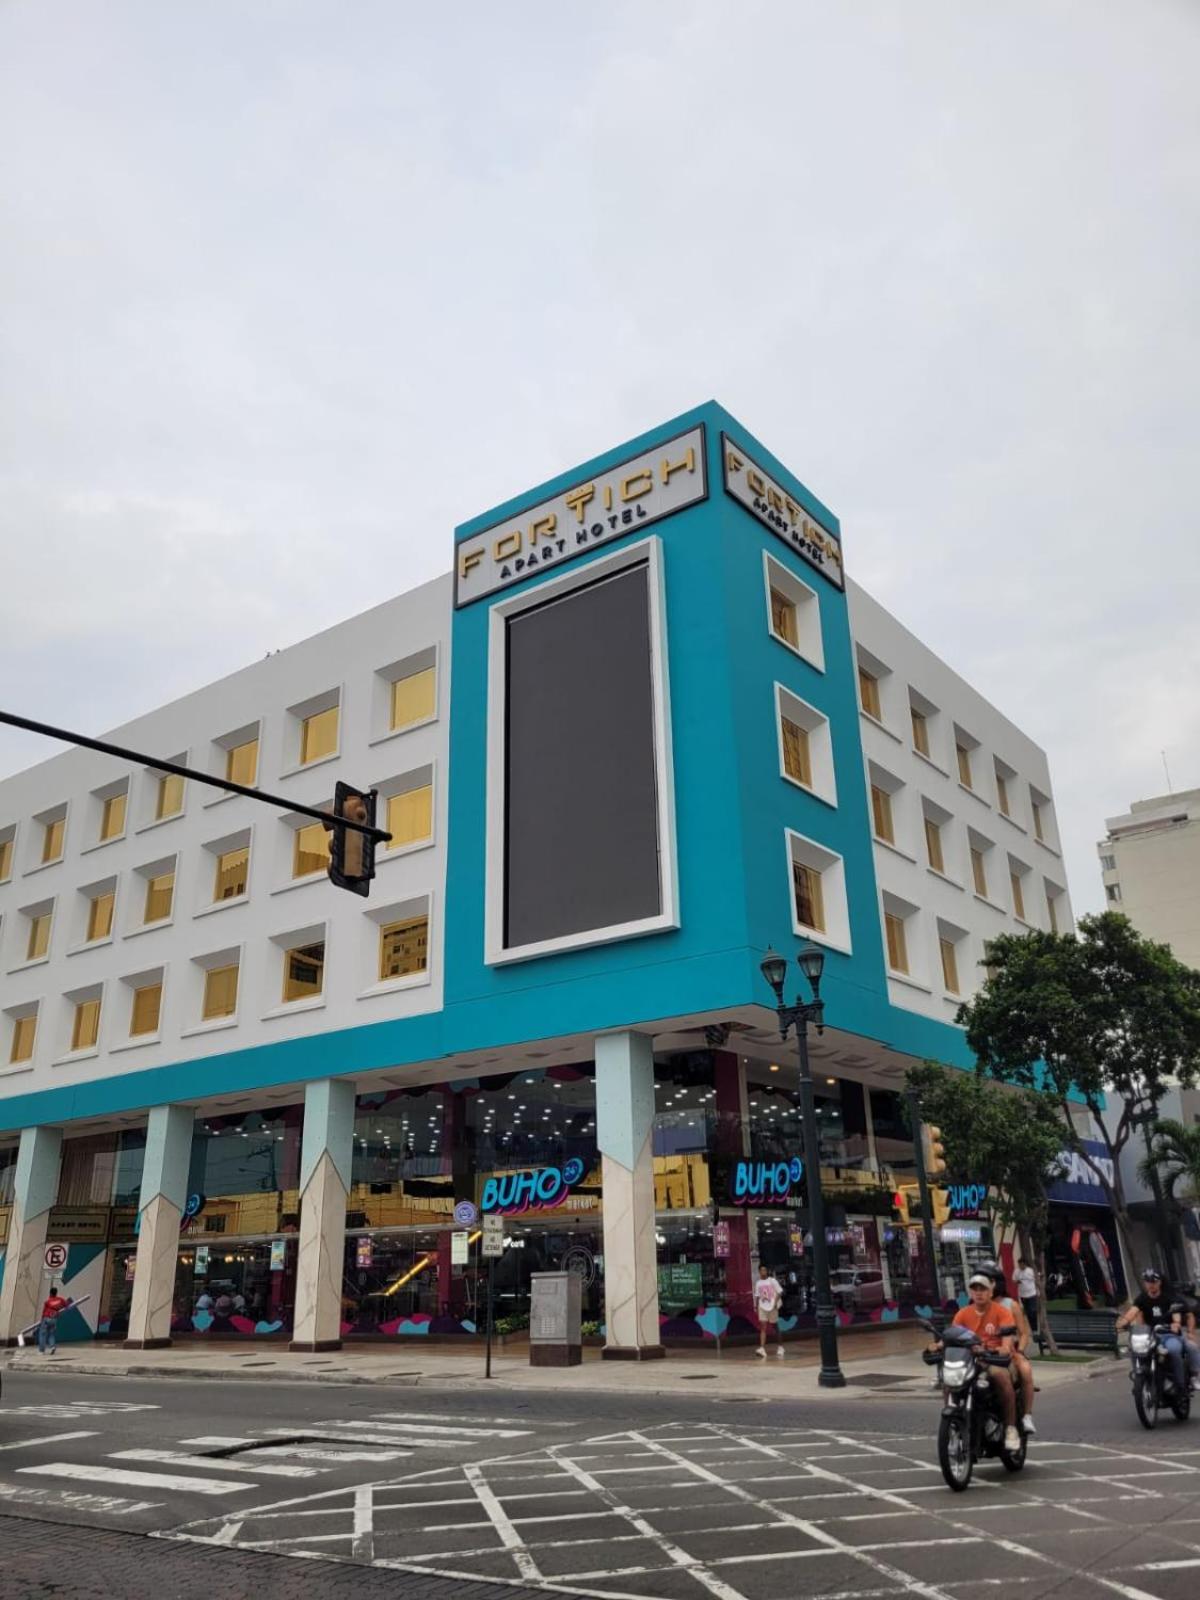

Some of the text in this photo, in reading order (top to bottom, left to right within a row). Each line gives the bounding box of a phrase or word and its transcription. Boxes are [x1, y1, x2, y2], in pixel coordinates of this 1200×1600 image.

[459, 447, 696, 579] FORTICH
[500, 503, 648, 579] APART HOTEL
[727, 452, 841, 567] FORTICH
[752, 497, 825, 565] APART HOTEL
[481, 1167, 562, 1211] BUHO
[735, 1162, 790, 1196] BUHO
